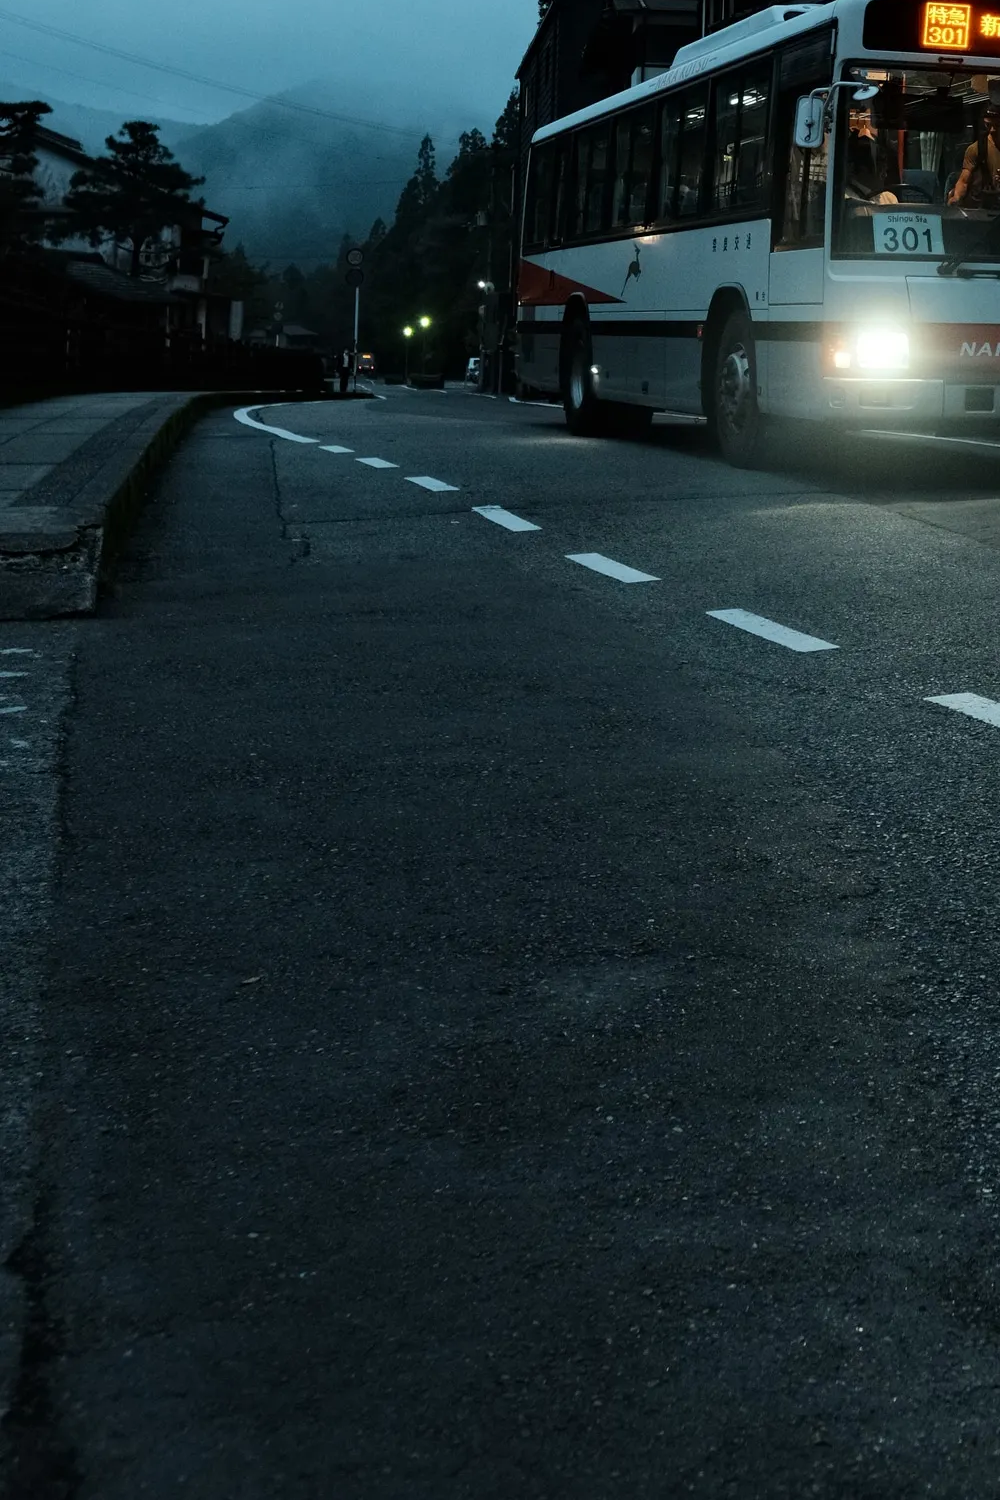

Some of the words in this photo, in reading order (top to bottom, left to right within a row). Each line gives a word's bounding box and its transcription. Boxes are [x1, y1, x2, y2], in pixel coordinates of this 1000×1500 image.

[928, 5, 967, 26] 特急
[928, 26, 965, 45] 301
[887, 215, 914, 224] Shingu
[883, 226, 933, 253] 301
